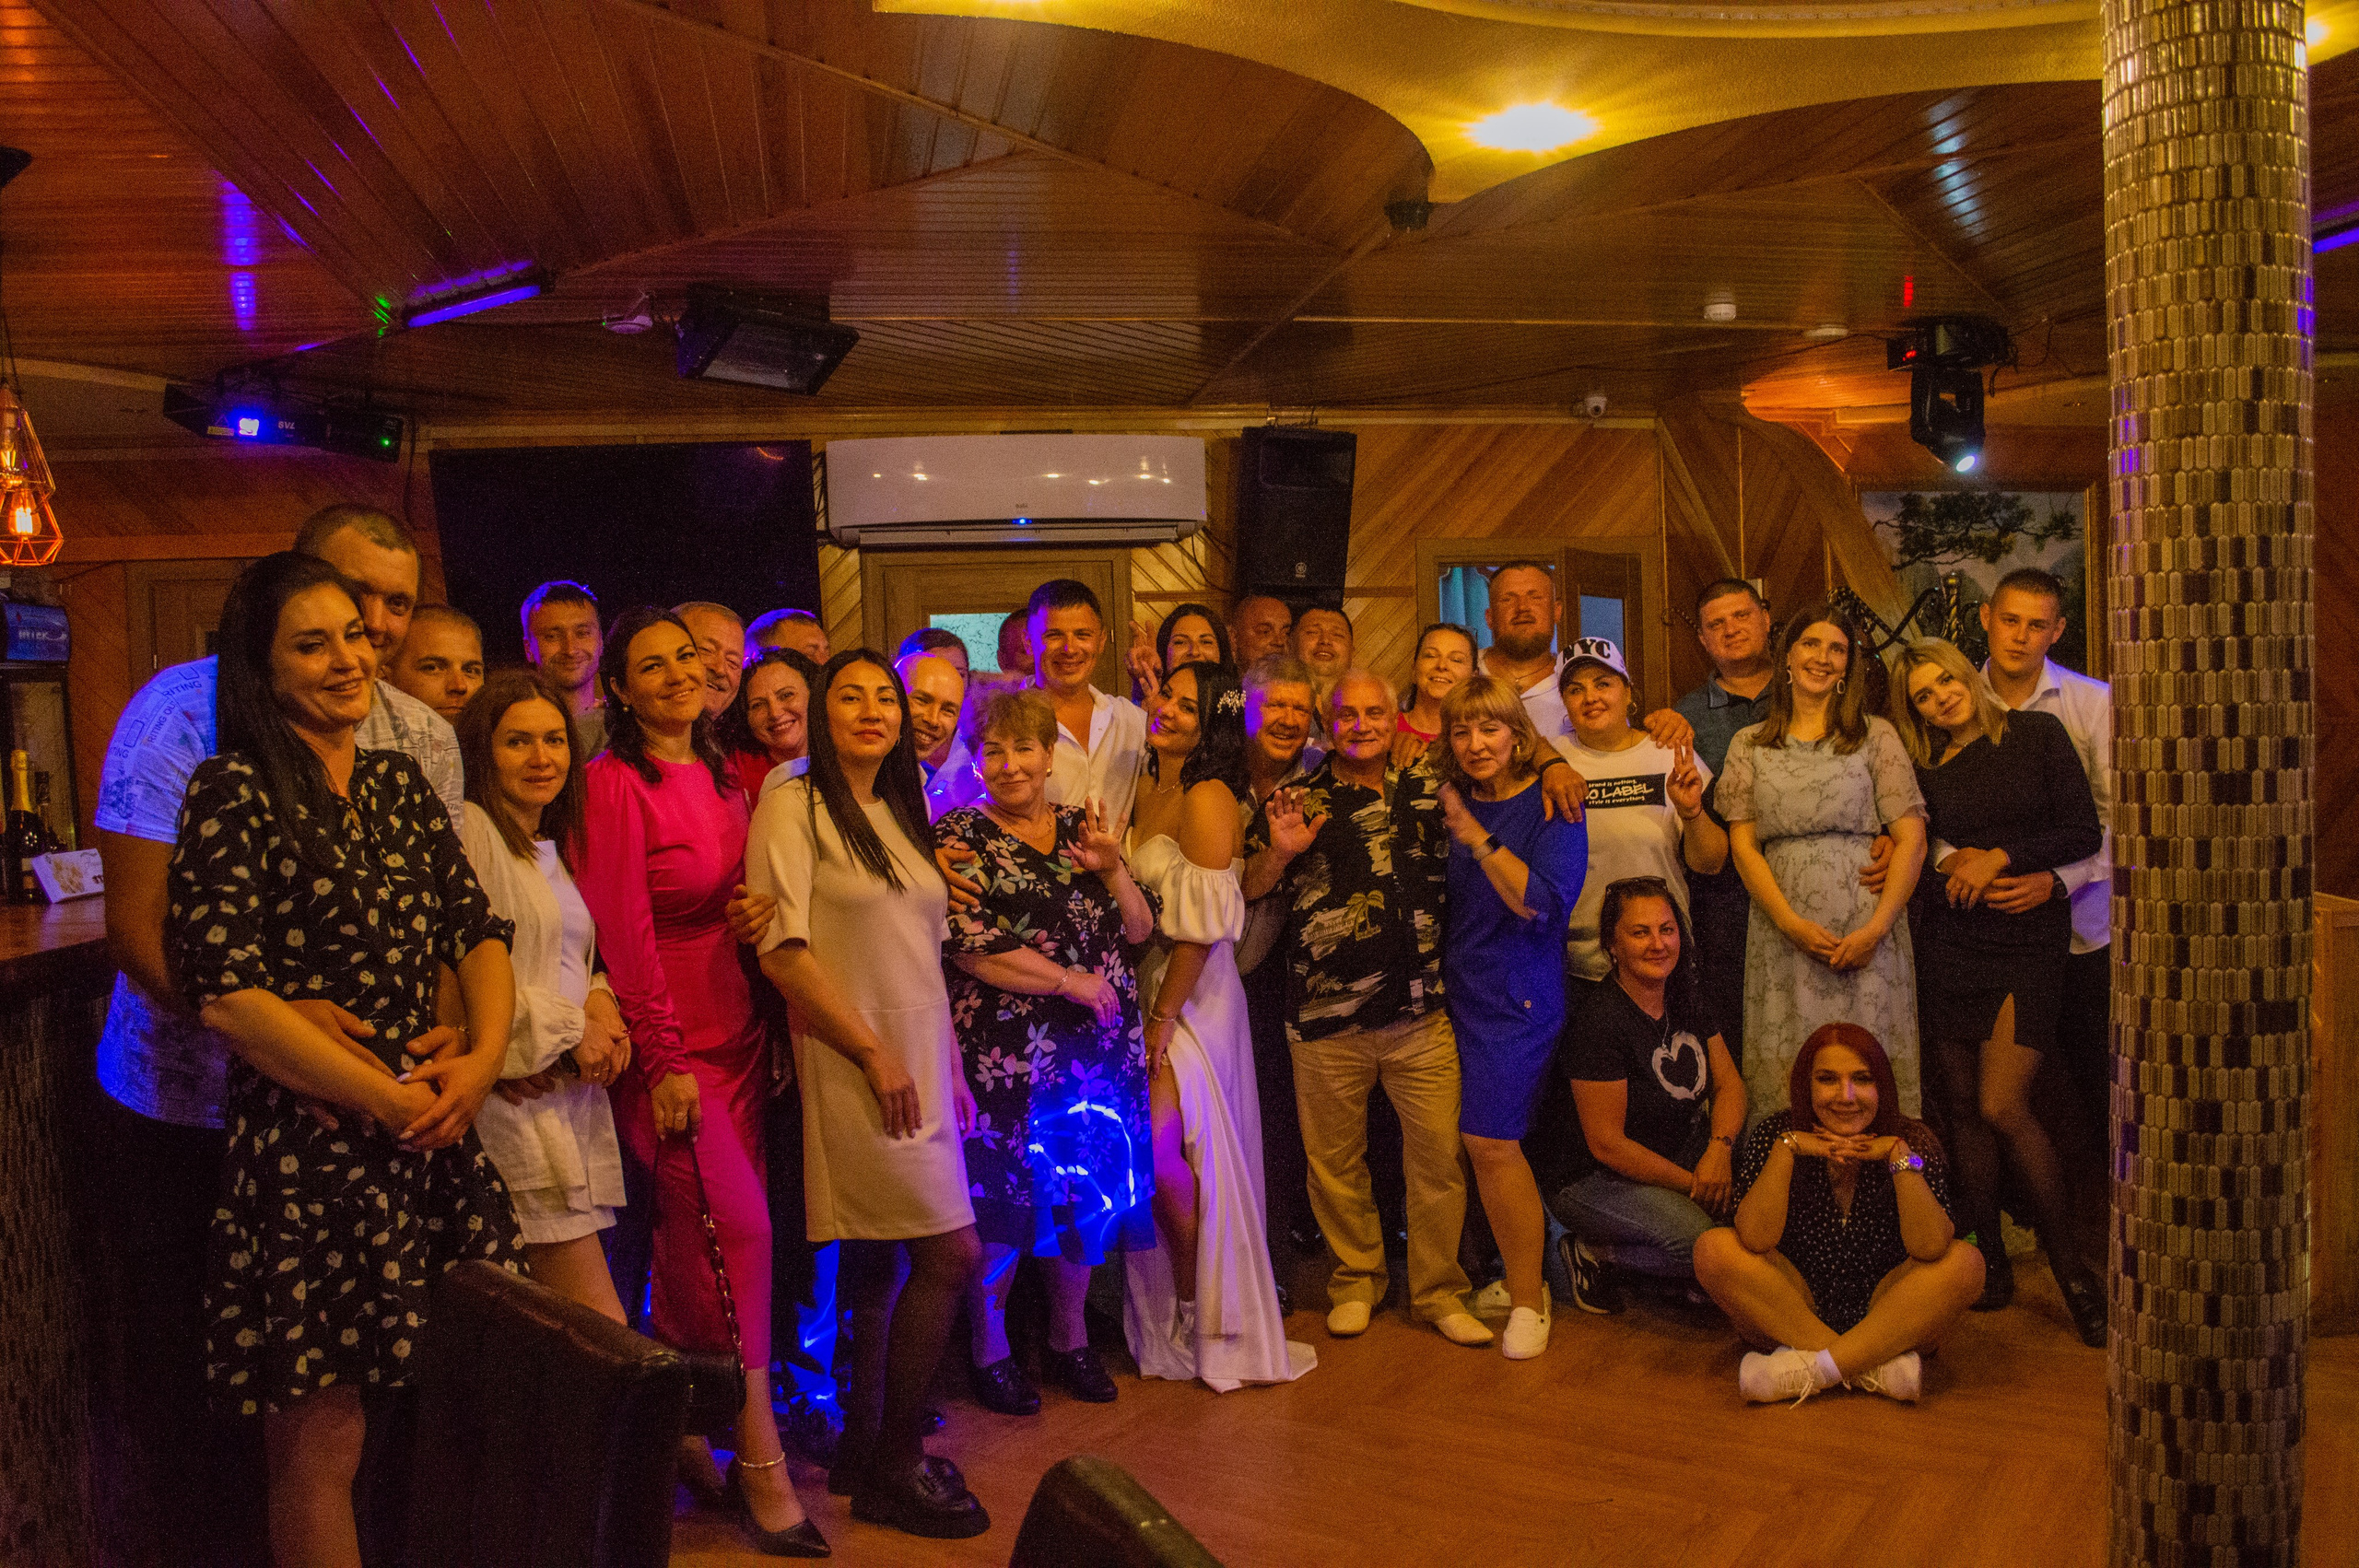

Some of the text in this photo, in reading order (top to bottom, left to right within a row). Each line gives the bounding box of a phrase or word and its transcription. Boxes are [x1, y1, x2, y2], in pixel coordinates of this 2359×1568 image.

[1563, 638, 1611, 663] NYC
[1585, 783, 1654, 800] O LABEL
